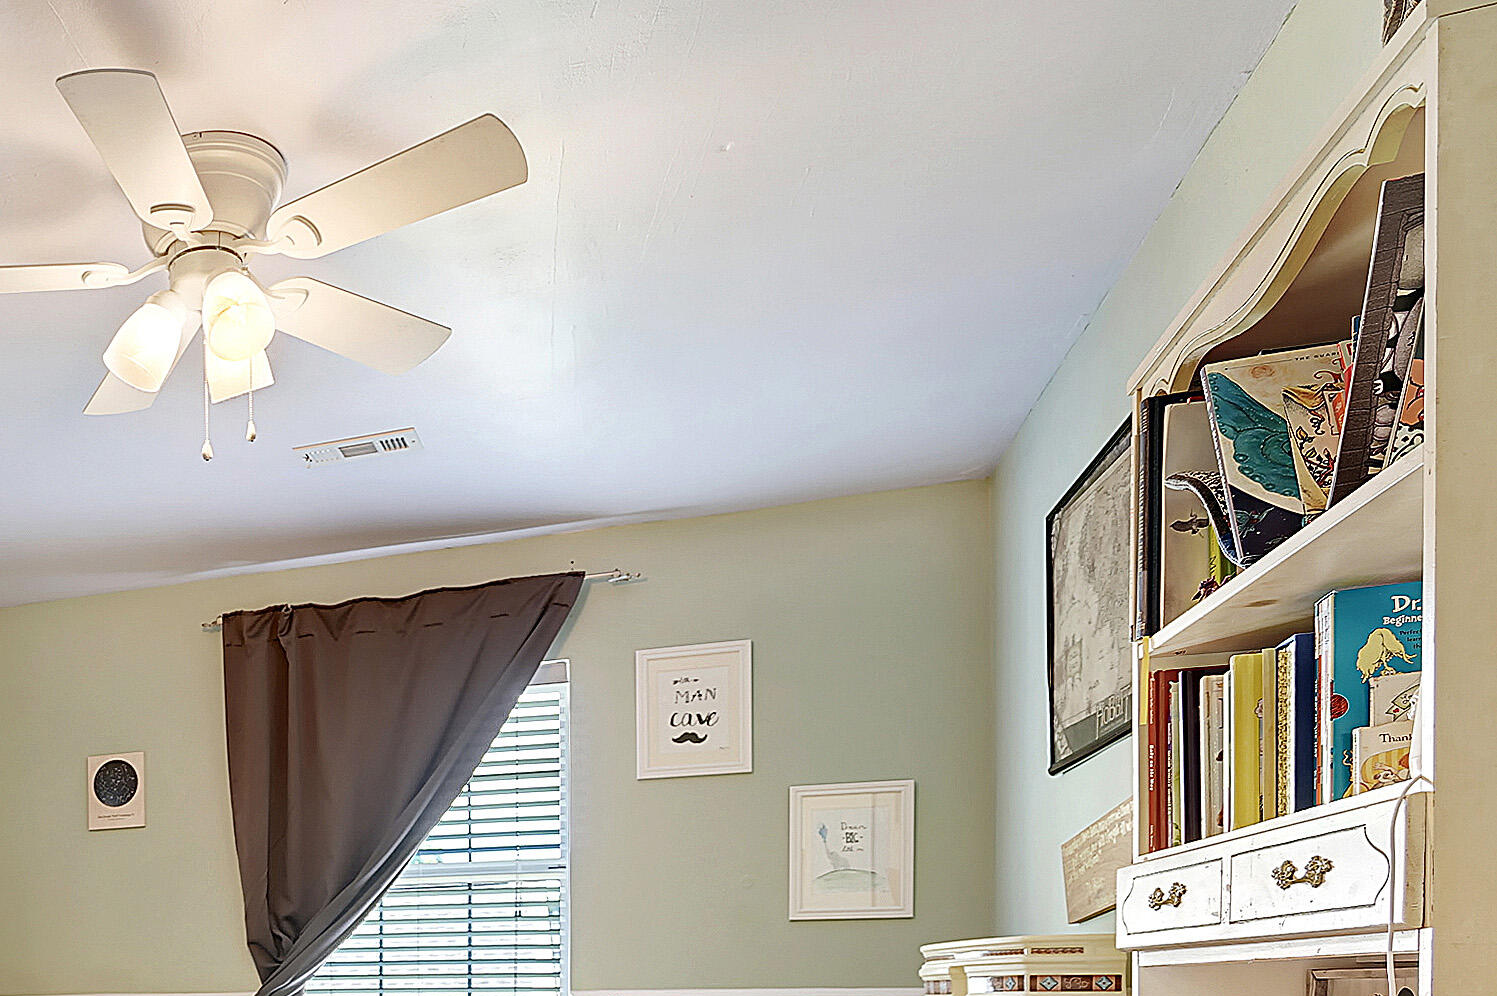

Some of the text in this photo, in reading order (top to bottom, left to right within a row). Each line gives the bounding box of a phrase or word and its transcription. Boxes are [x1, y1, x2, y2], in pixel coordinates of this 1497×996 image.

[1390, 595, 1422, 613] Dr.
[675, 688, 717, 704] MAN
[670, 711, 720, 727] cave
